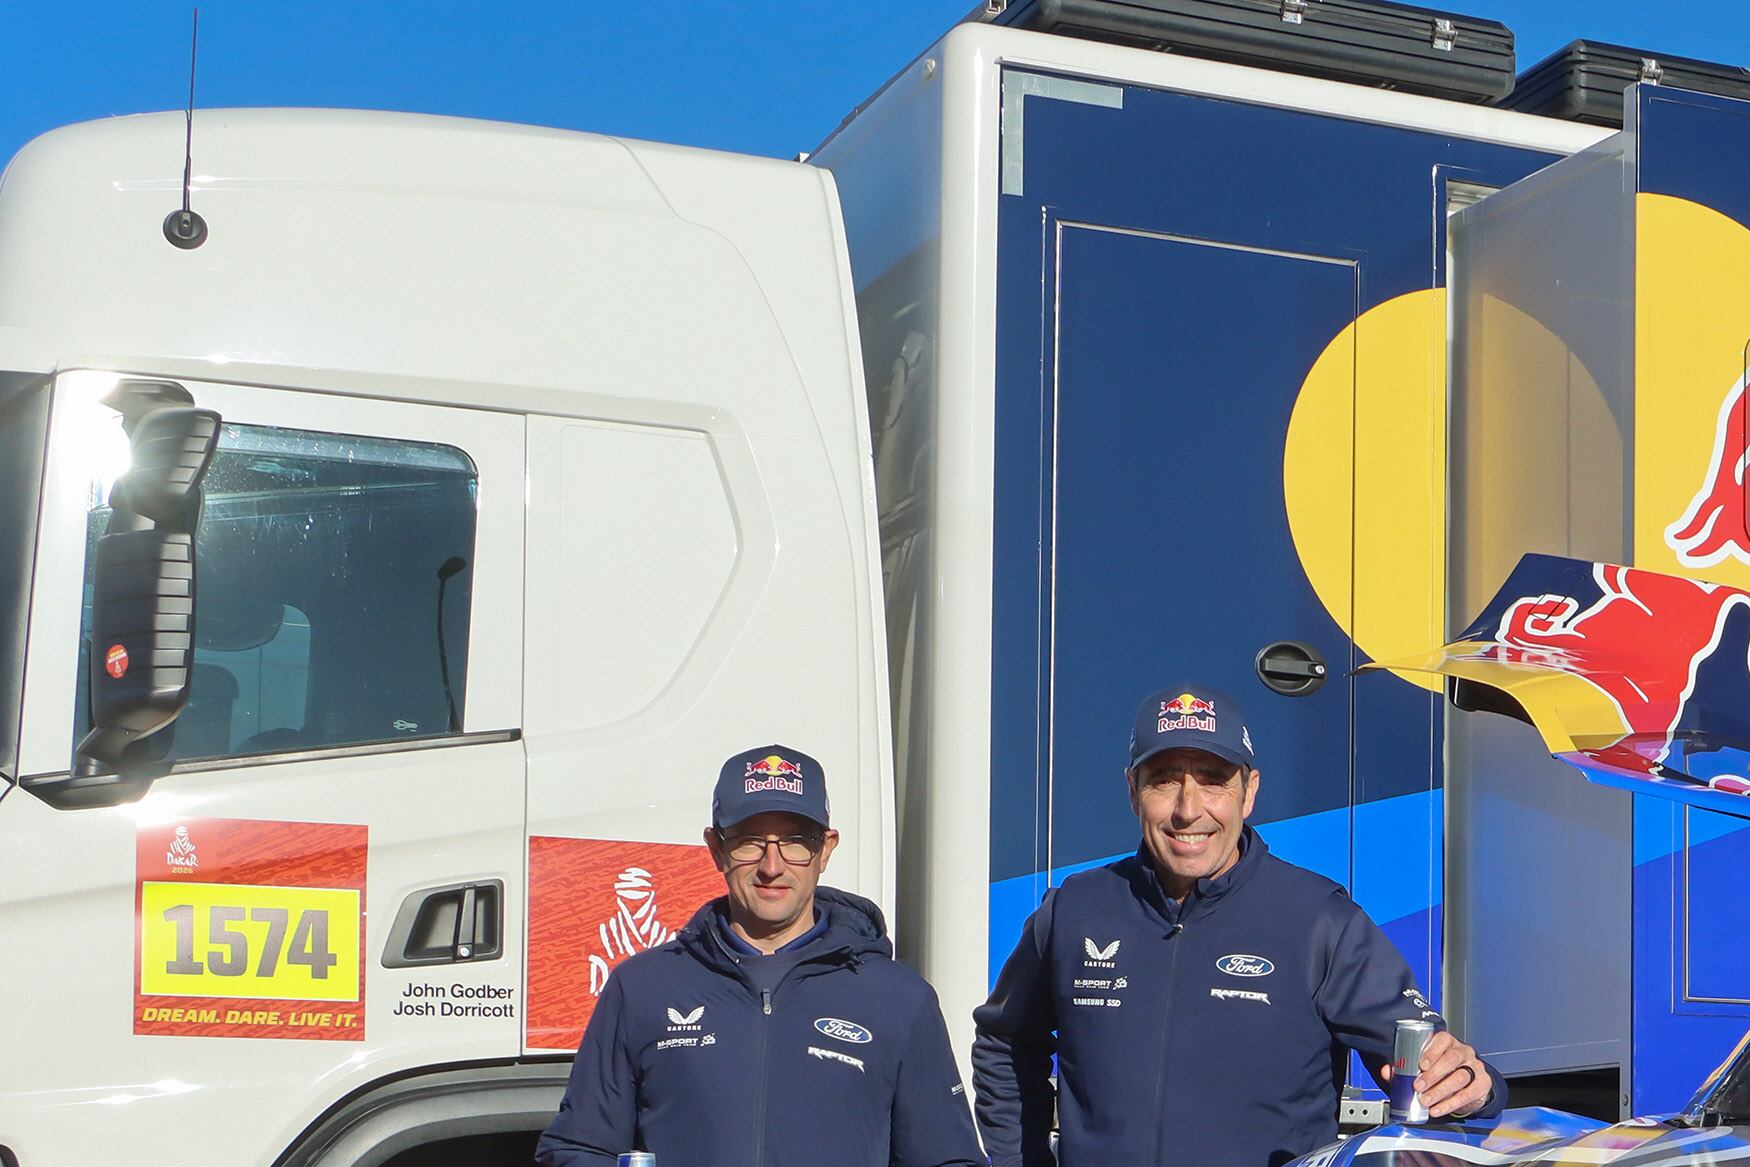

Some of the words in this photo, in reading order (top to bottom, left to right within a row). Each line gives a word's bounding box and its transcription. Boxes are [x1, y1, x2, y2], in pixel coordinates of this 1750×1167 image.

[1157, 715, 1186, 733] Red
[1186, 715, 1216, 733] Bull
[744, 776, 775, 793] Red
[775, 777, 803, 795] Bull
[171, 866, 193, 874] 2026
[163, 904, 337, 979] 1574
[1225, 956, 1265, 974] Ford
[402, 983, 446, 998] John
[450, 983, 514, 999] Godber
[1074, 979, 1112, 987] M-SPORT
[1073, 998, 1104, 1006] SAMSUNG
[1106, 999, 1121, 1007] SSD
[1210, 988, 1271, 1005] RAPTOR
[142, 1007, 220, 1024] DREAM.
[225, 1010, 283, 1026] DARE.
[288, 1012, 332, 1027] LIVE
[335, 1013, 357, 1028] IT.
[393, 1001, 435, 1016] Josh
[440, 1002, 514, 1017] Dorricott
[823, 1020, 863, 1041] Ford
[657, 1038, 699, 1048] M-SPORT
[807, 1046, 865, 1074] RAPTOR
